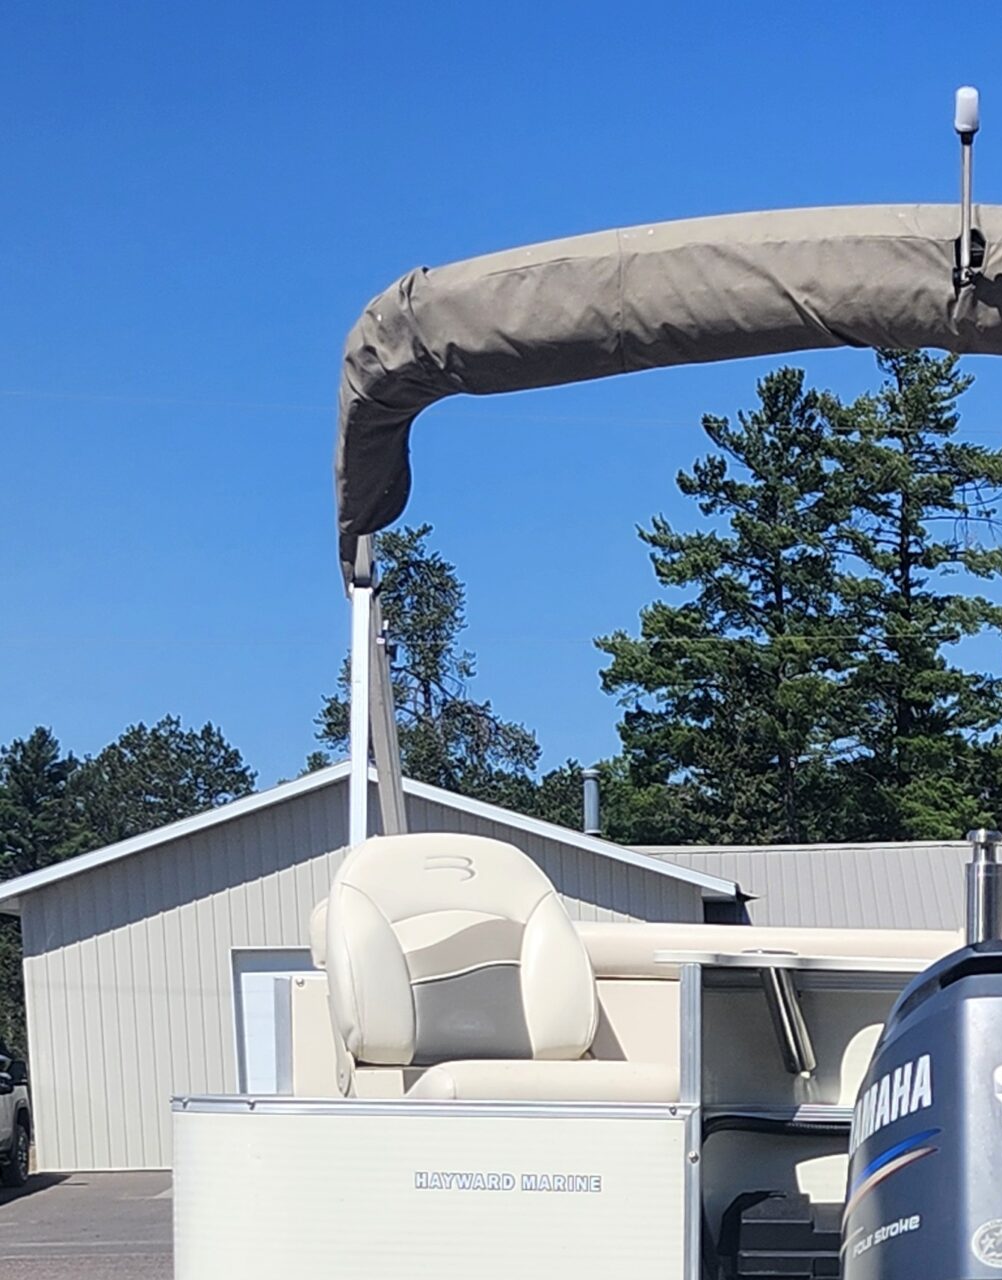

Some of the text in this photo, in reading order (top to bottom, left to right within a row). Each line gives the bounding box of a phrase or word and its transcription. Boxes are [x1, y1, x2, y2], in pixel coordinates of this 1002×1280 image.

[849, 1053, 932, 1159] AMAHA
[415, 1171, 602, 1193] HAYWARD MARINE
